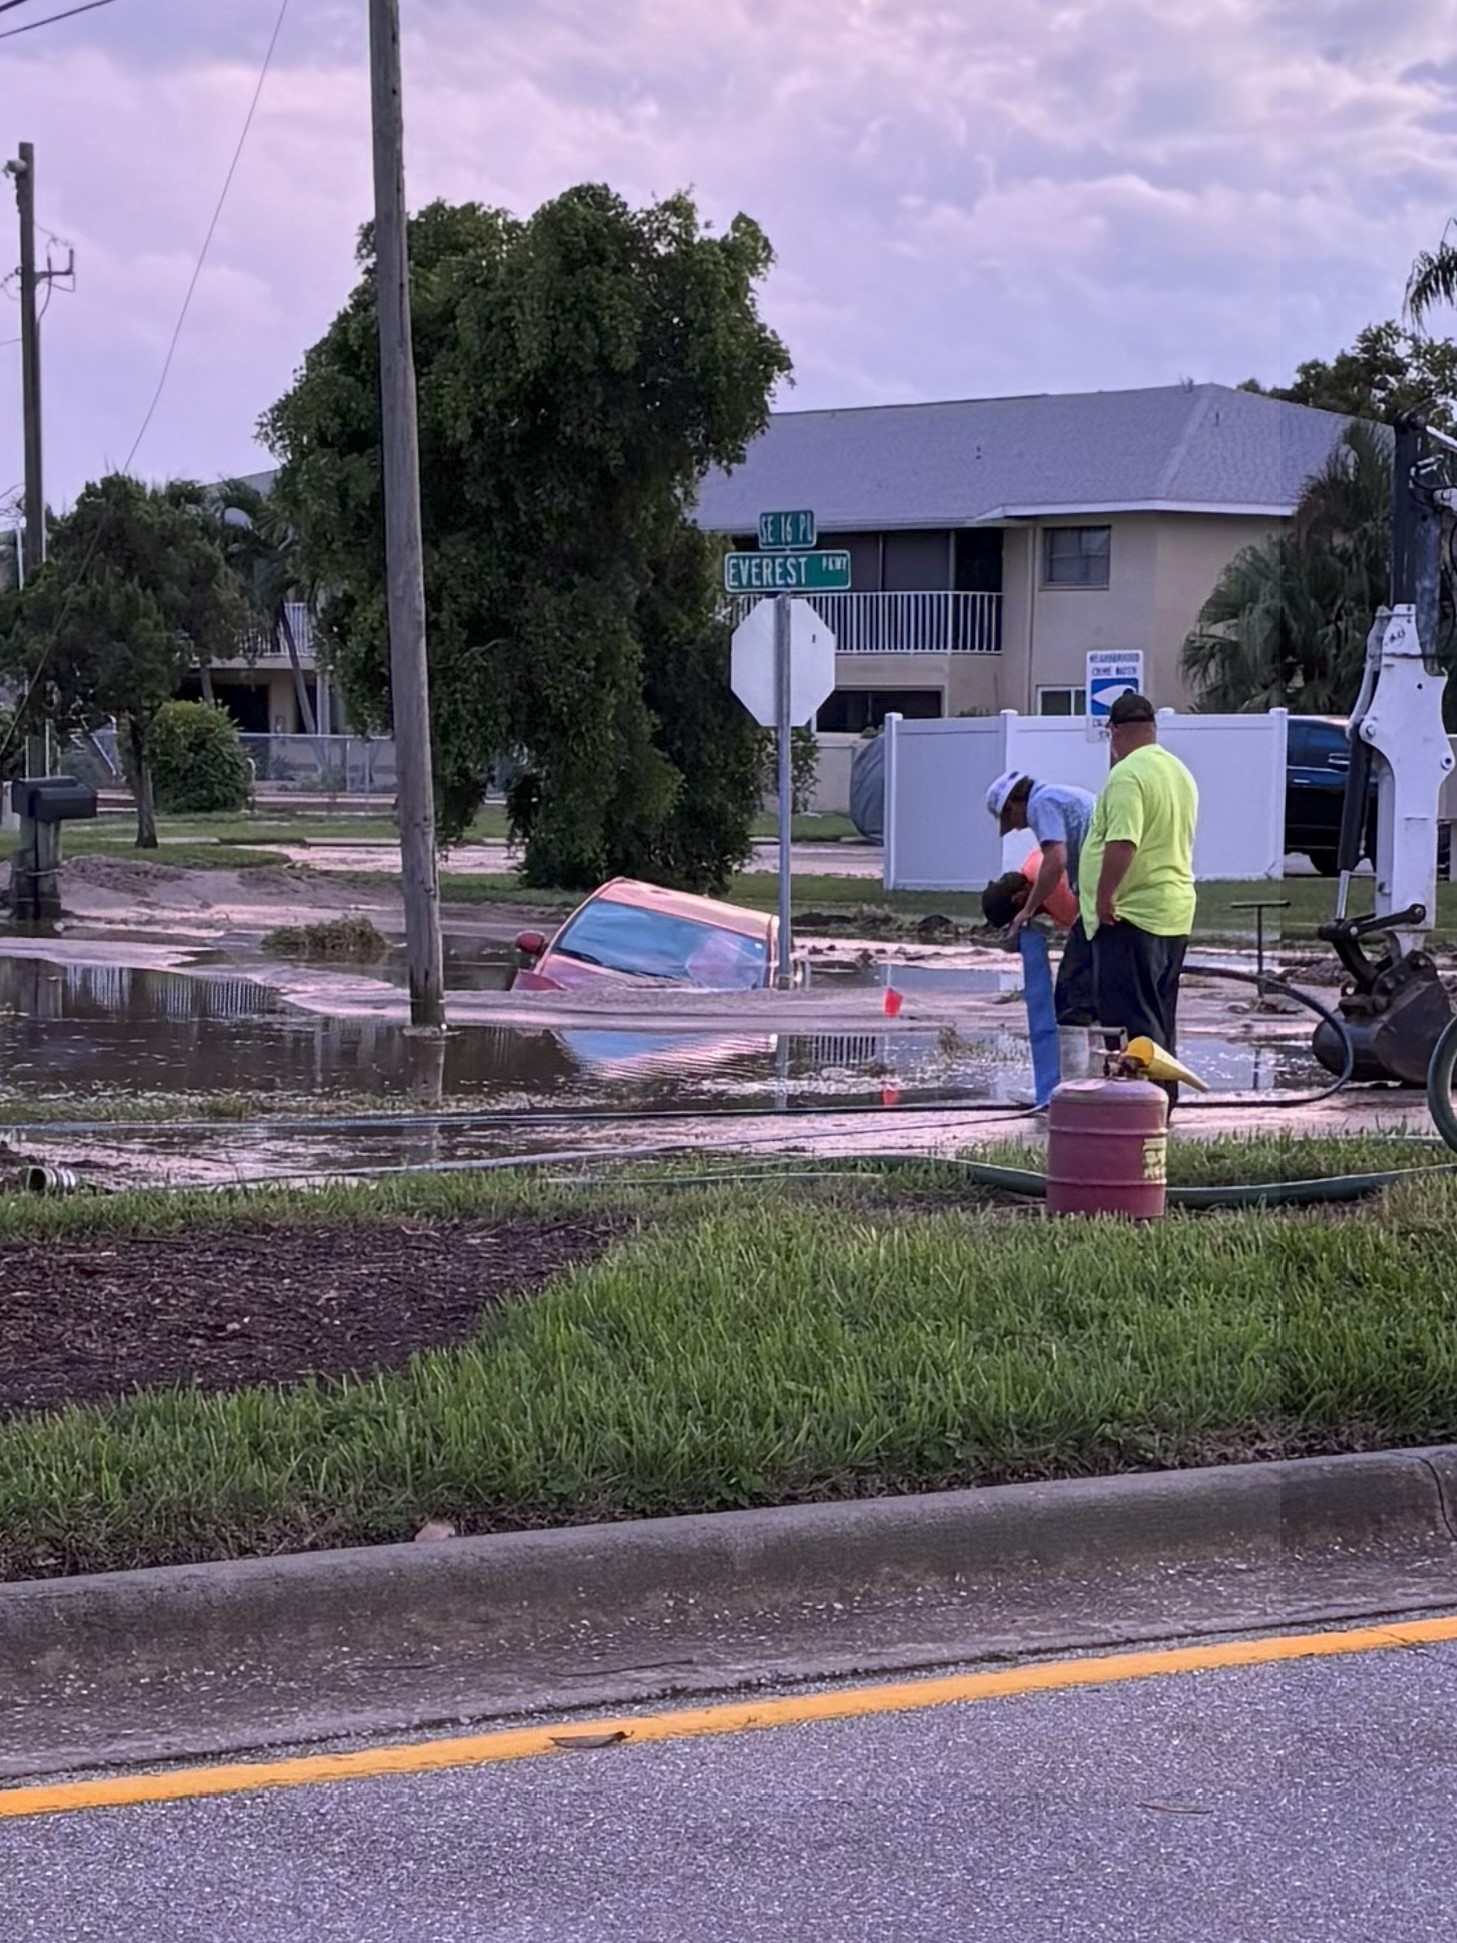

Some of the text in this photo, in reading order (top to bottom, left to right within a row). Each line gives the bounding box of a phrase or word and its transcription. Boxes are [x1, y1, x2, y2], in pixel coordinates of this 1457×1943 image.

[761, 512, 812, 543] SE 16 PL
[729, 557, 808, 586] EVEREST
